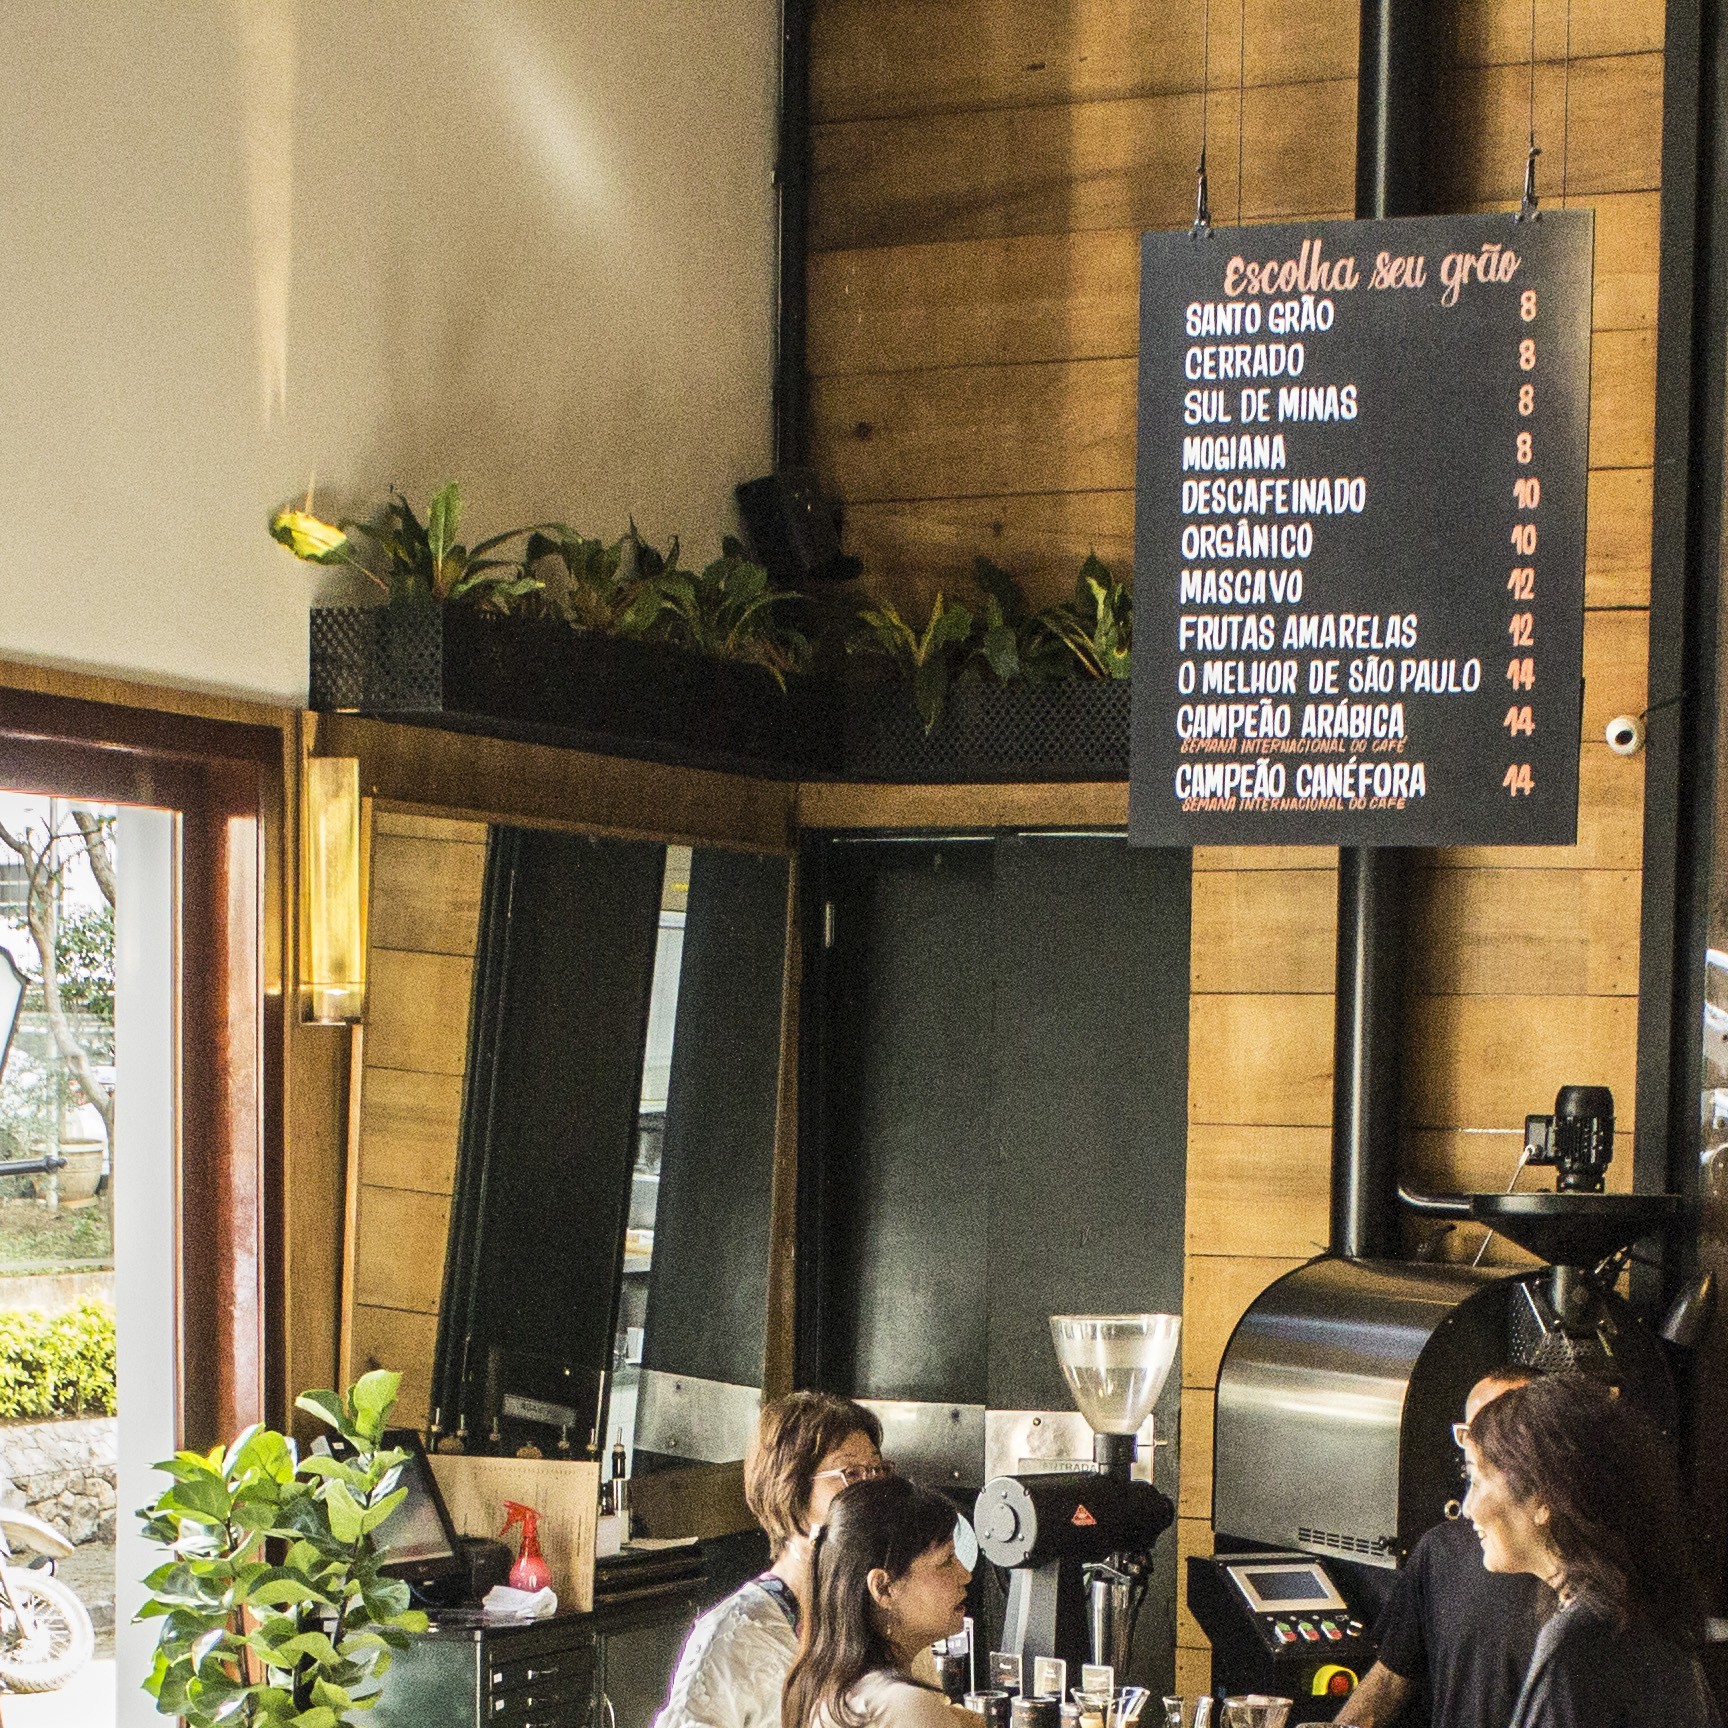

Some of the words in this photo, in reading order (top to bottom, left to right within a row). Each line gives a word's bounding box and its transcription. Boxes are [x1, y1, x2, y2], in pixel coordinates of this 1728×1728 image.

[1224, 239, 1360, 296] Escolha
[1369, 249, 1426, 288] seu
[1440, 242, 1521, 307] grão
[1185, 302, 1261, 337] SANTO
[1268, 293, 1335, 332] GRÃO
[1520, 289, 1537, 322] 8
[1184, 342, 1305, 381] CERRADO
[1518, 338, 1536, 371] 8
[1184, 388, 1231, 426] SUL
[1240, 387, 1271, 423] DE
[1277, 385, 1359, 422] MINAS
[1518, 384, 1535, 416] 8
[1182, 433, 1285, 472] MOGIANA
[1516, 431, 1533, 464] 8
[1181, 476, 1366, 516] DESCAFEINADO
[1513, 477, 1540, 510] 10
[1181, 519, 1314, 560] ORGÂNICO
[1511, 524, 1536, 555] 10
[1179, 568, 1303, 605] MASCAVO
[1507, 566, 1536, 602] 12
[1179, 613, 1275, 653] FRUTAS
[1282, 612, 1418, 651] AMARELAS
[1508, 611, 1534, 647] 12
[1178, 660, 1197, 695] O
[1202, 658, 1297, 695] MELHOR
[1308, 659, 1340, 694] DE
[1348, 651, 1394, 693] SÃO
[1399, 658, 1481, 693] PAULO
[1506, 658, 1536, 692] 14
[1176, 698, 1291, 740] CAMPEÃO
[1300, 698, 1406, 739] ARÁBICA
[1503, 705, 1536, 737] 14
[1180, 738, 1238, 754] SEMANA
[1240, 738, 1346, 754] INTERNACIONAL
[1175, 757, 1286, 800] CAMPEÃO
[1295, 756, 1426, 798] CANÉFORA
[1503, 764, 1535, 797] 14
[1182, 796, 1237, 812] SEMANA
[1239, 797, 1344, 812] INTERNACIONAL
